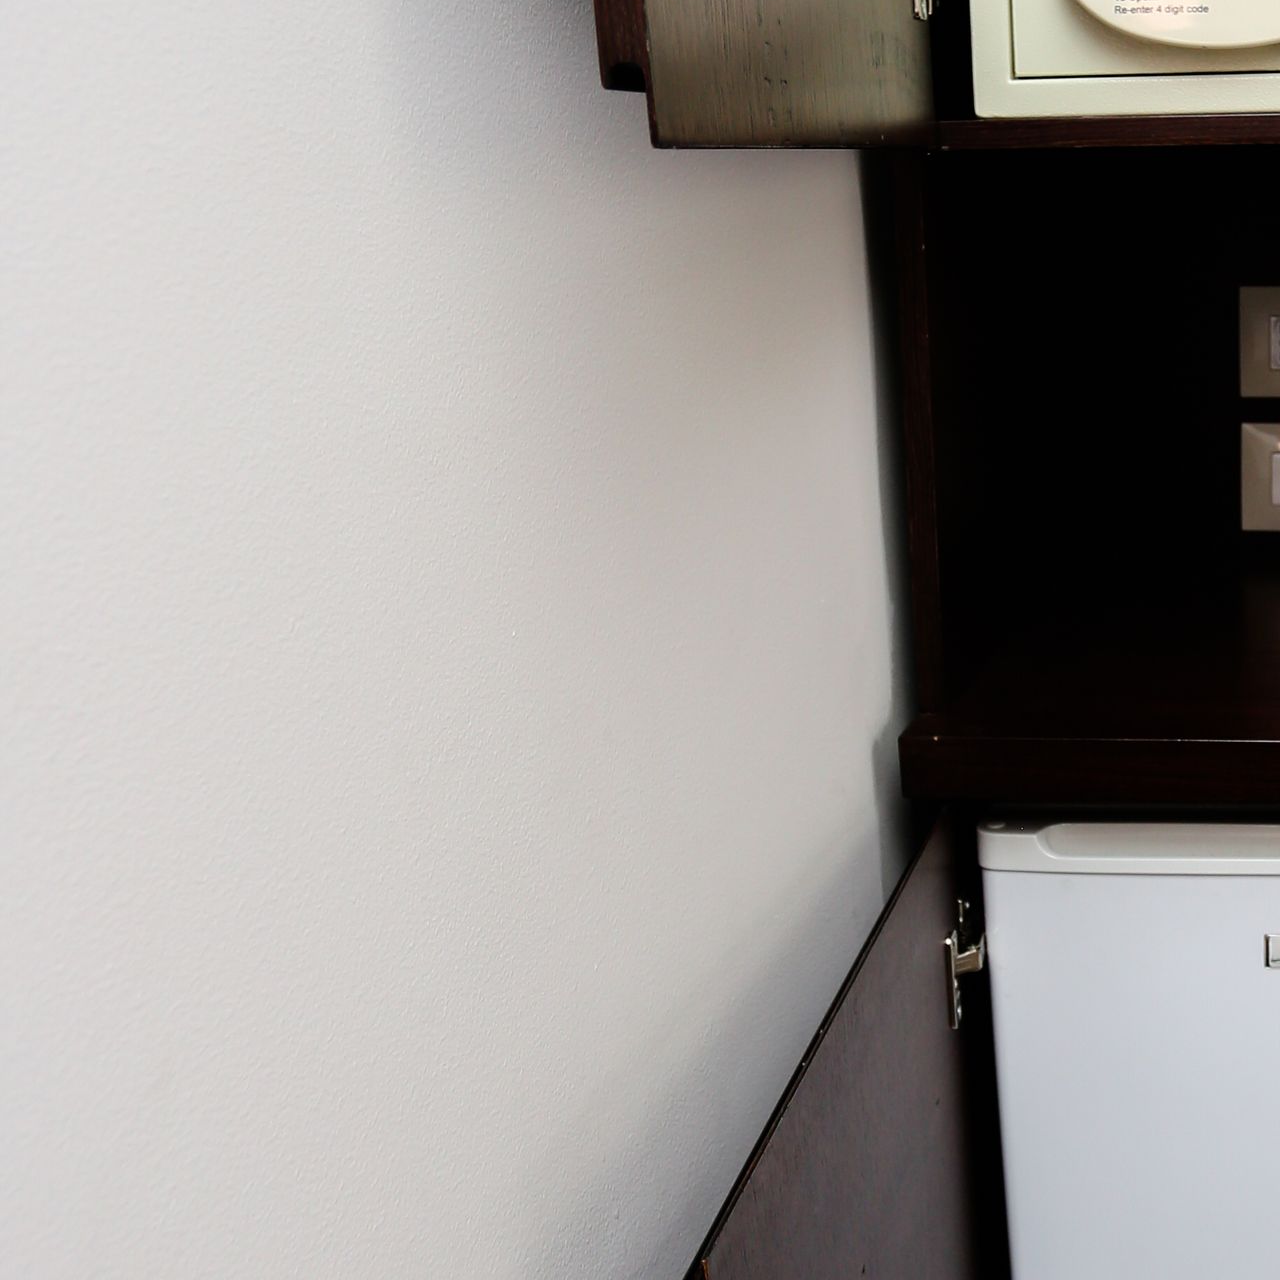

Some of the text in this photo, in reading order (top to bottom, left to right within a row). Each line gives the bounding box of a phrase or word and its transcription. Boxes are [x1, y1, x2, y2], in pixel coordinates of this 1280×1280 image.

[1114, 5, 1153, 14] Re-enter
[1164, 4, 1184, 15] digit
[1186, 4, 1209, 13] code
